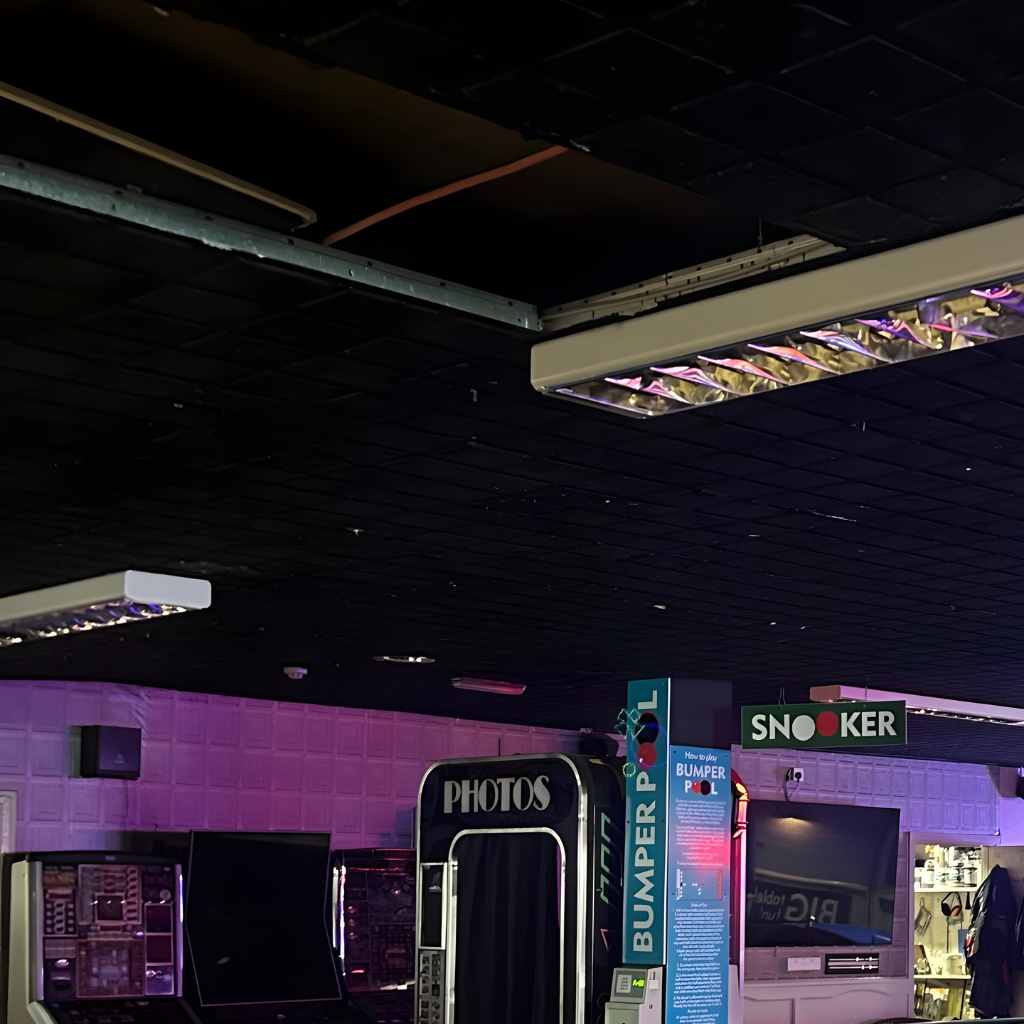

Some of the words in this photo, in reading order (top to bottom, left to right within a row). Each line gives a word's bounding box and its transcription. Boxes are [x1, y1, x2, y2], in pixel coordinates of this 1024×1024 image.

[751, 710, 898, 742] SNOOKER
[684, 751, 698, 760] How
[698, 753, 706, 761] to
[705, 753, 718, 762] play
[676, 763, 726, 780] BUMPER
[443, 775, 551, 814] PHOTOS
[684, 779, 719, 796] POOL
[633, 800, 656, 952] BUMPER
